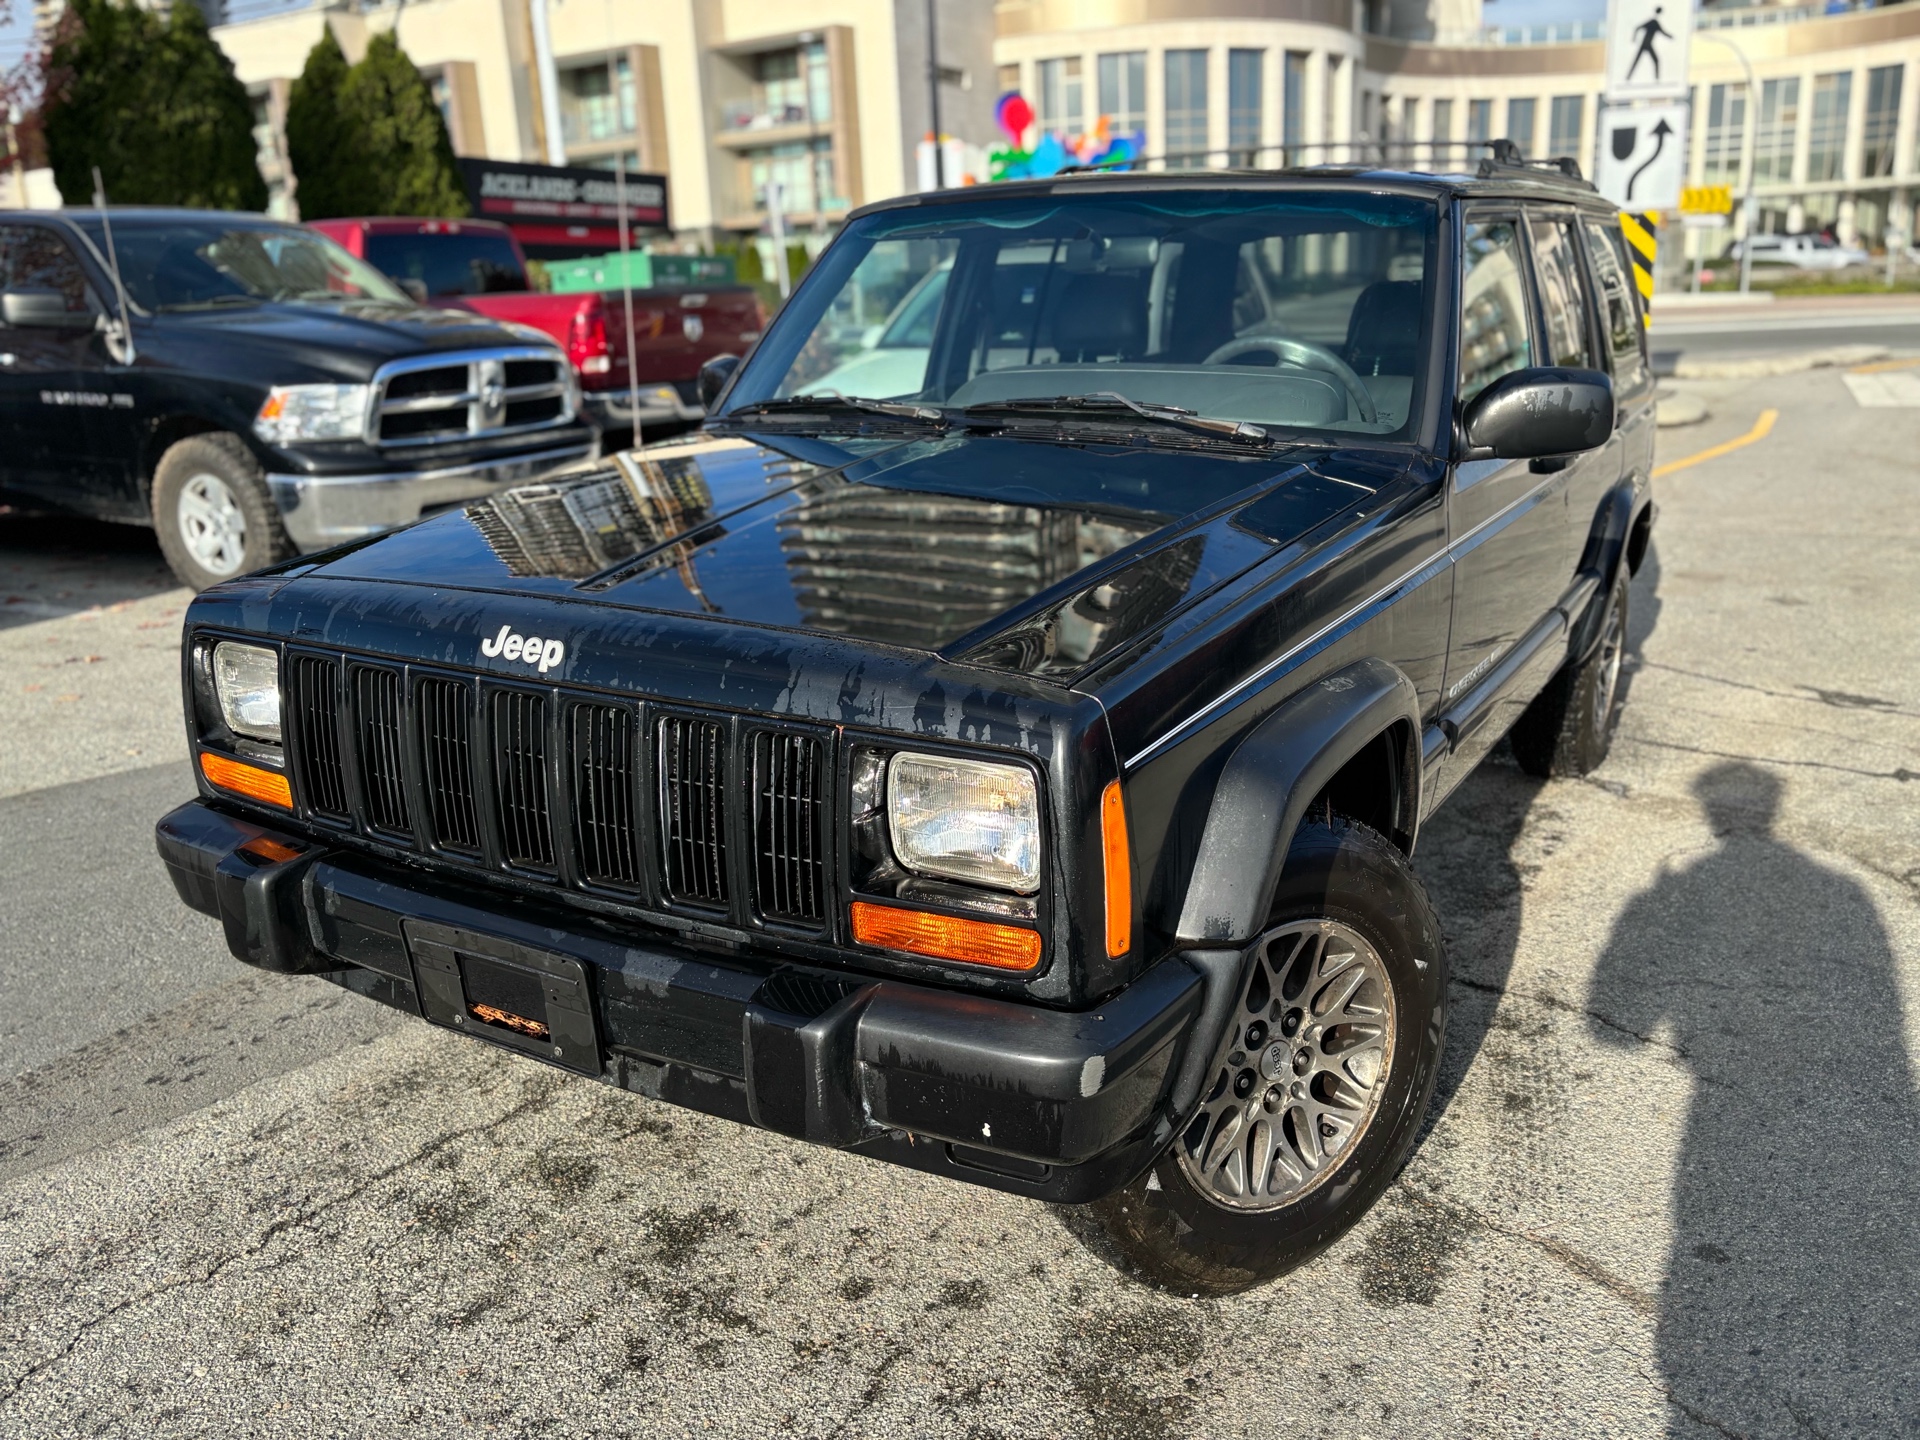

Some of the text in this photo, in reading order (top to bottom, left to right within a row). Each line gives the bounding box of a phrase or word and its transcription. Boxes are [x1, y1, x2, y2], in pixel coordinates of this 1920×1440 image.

[480, 172, 663, 207] ACKLANDS-GRANGER
[482, 625, 564, 672] Jeep
[1271, 1046, 1283, 1075] Jeep
